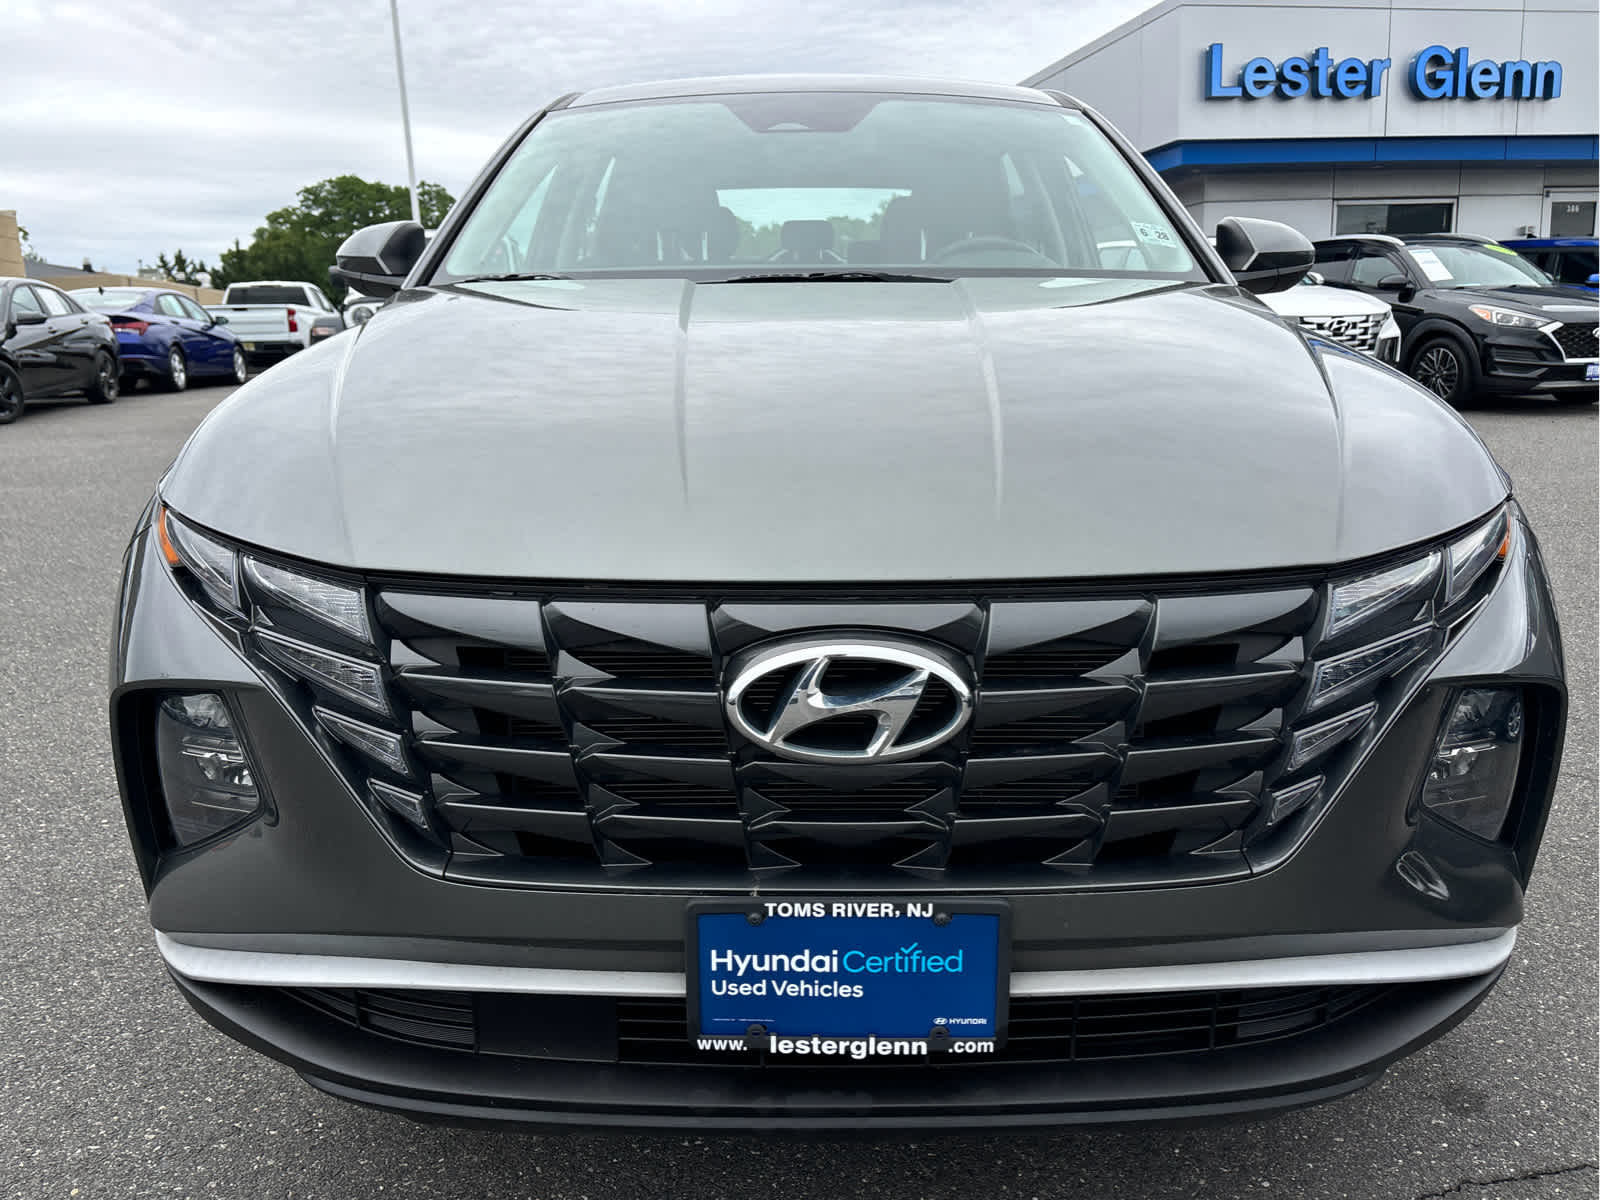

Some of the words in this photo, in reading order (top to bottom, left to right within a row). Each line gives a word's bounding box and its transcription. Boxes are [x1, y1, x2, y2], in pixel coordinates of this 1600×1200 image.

[1204, 42, 1391, 98] Lester
[1408, 45, 1563, 99] Glenn
[764, 903, 826, 918] TOMS
[832, 903, 900, 918] RIVER,
[907, 903, 934, 918] NJ
[711, 949, 839, 976] Hyundai
[843, 942, 963, 973] Certified
[711, 979, 767, 996] Used
[771, 979, 864, 998] Vehicles
[697, 1039, 748, 1051] www.
[769, 1035, 928, 1060] lesterglenn
[948, 1041, 994, 1054] .com
